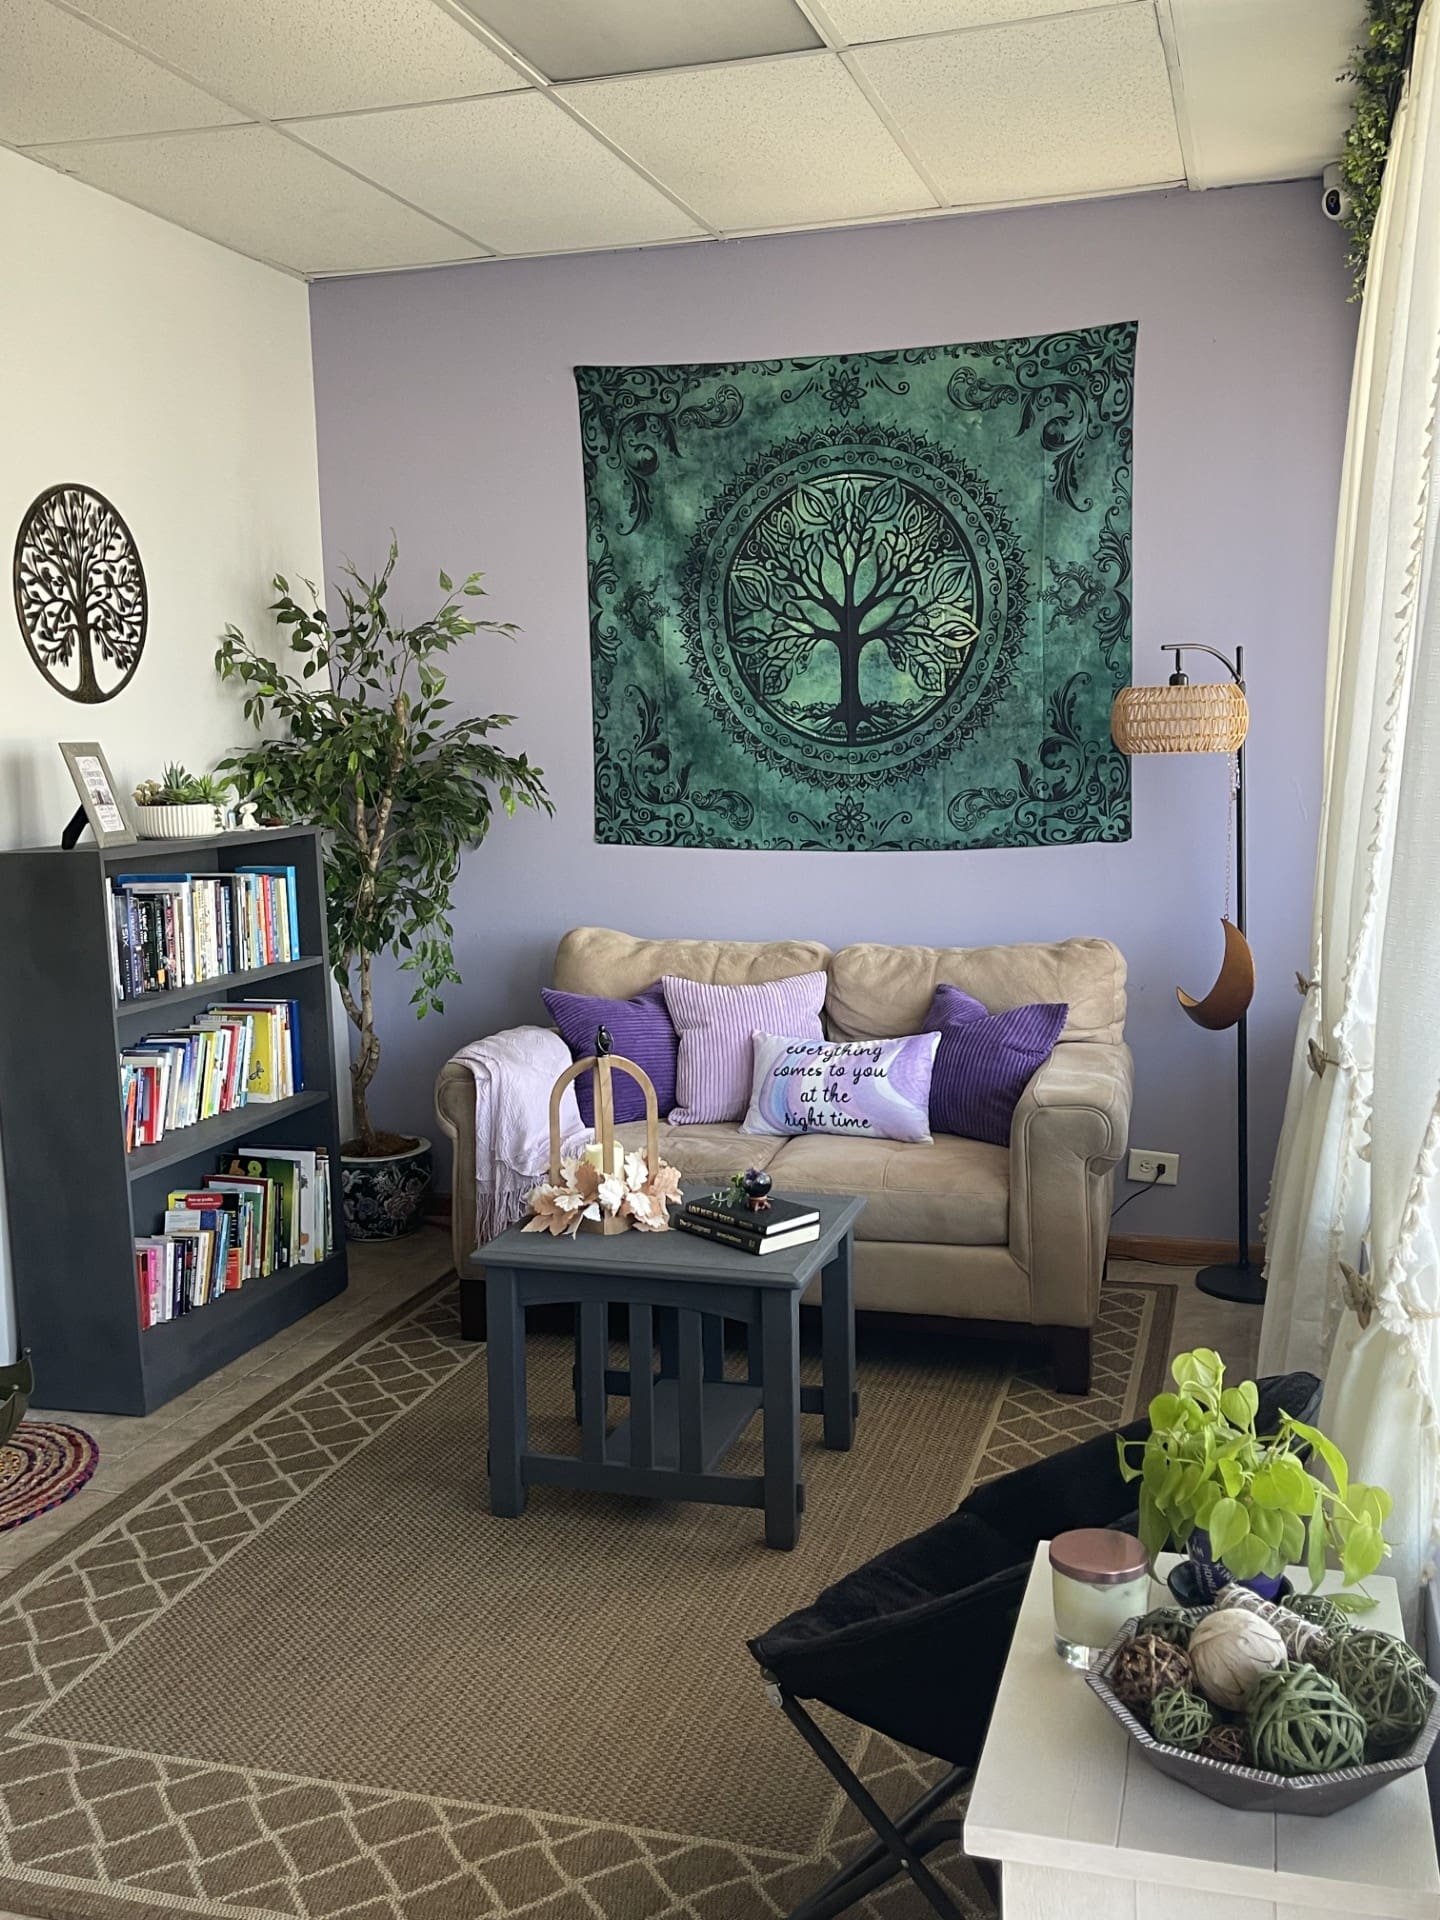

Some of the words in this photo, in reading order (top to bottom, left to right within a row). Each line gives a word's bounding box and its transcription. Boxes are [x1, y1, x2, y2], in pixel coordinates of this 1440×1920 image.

[786, 1043, 883, 1062] everything
[773, 1066, 823, 1077] comes
[829, 1064, 846, 1077] to
[853, 1066, 887, 1085] you
[800, 1087, 818, 1103] at
[823, 1082, 851, 1103] the
[784, 1107, 827, 1131] right
[830, 1113, 872, 1129] time
